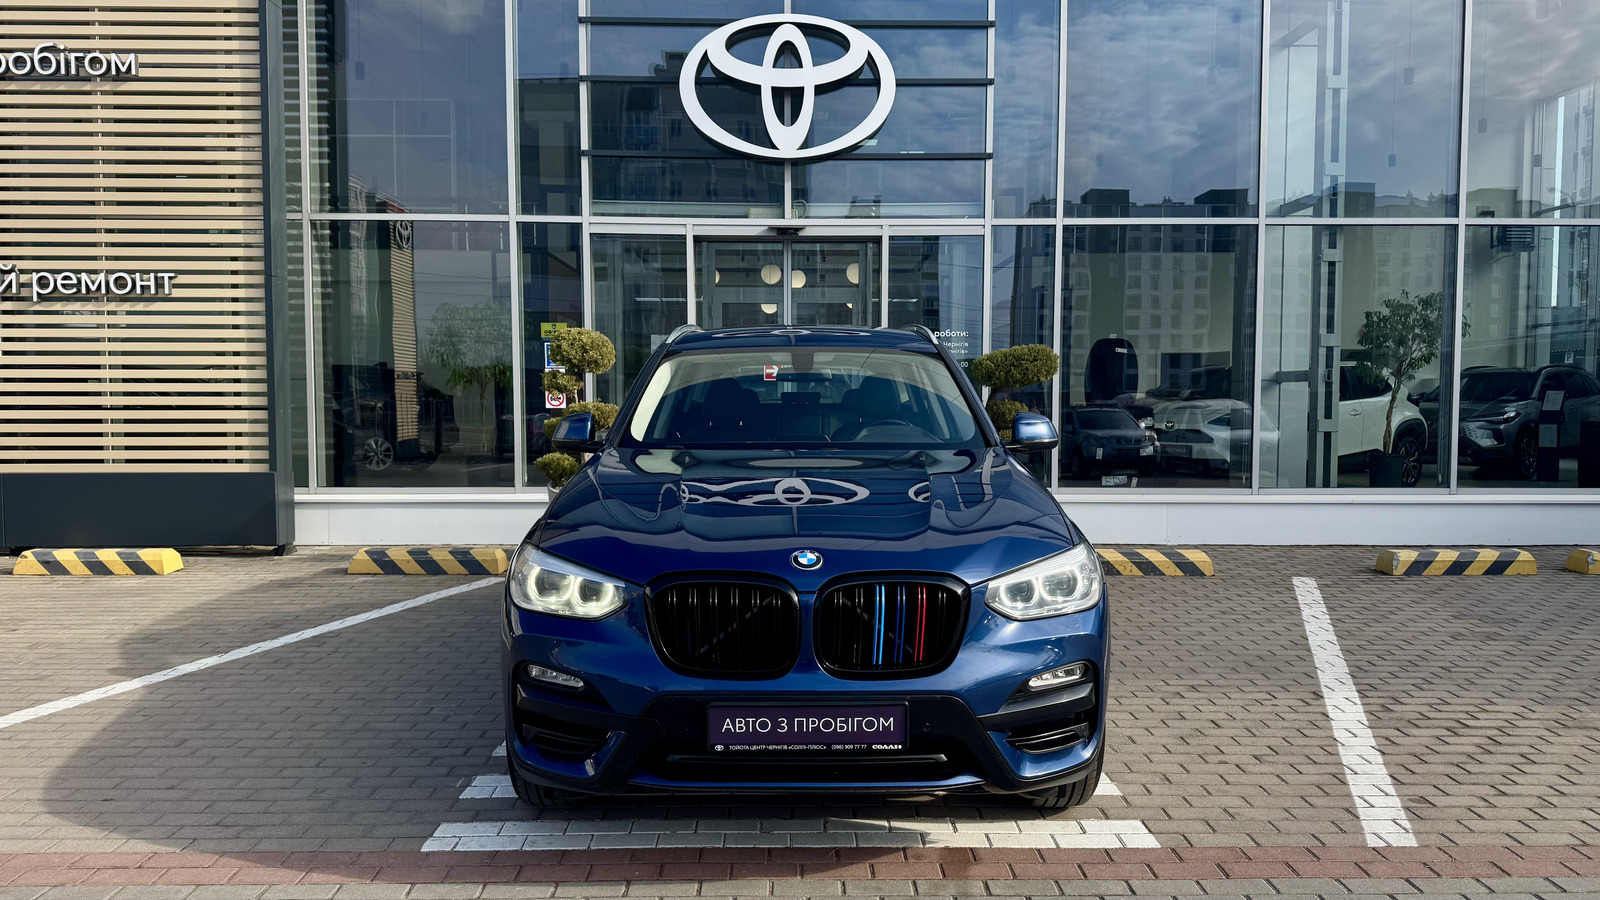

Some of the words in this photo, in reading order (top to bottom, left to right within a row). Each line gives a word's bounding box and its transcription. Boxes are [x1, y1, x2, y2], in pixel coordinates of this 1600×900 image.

[0, 42, 138, 75] обігом
[32, 272, 176, 302] ремонт
[934, 329, 968, 337] роботи:
[721, 718, 771, 732] АВТО
[777, 718, 788, 732] З
[794, 717, 894, 732] ПРОБІГОМ
